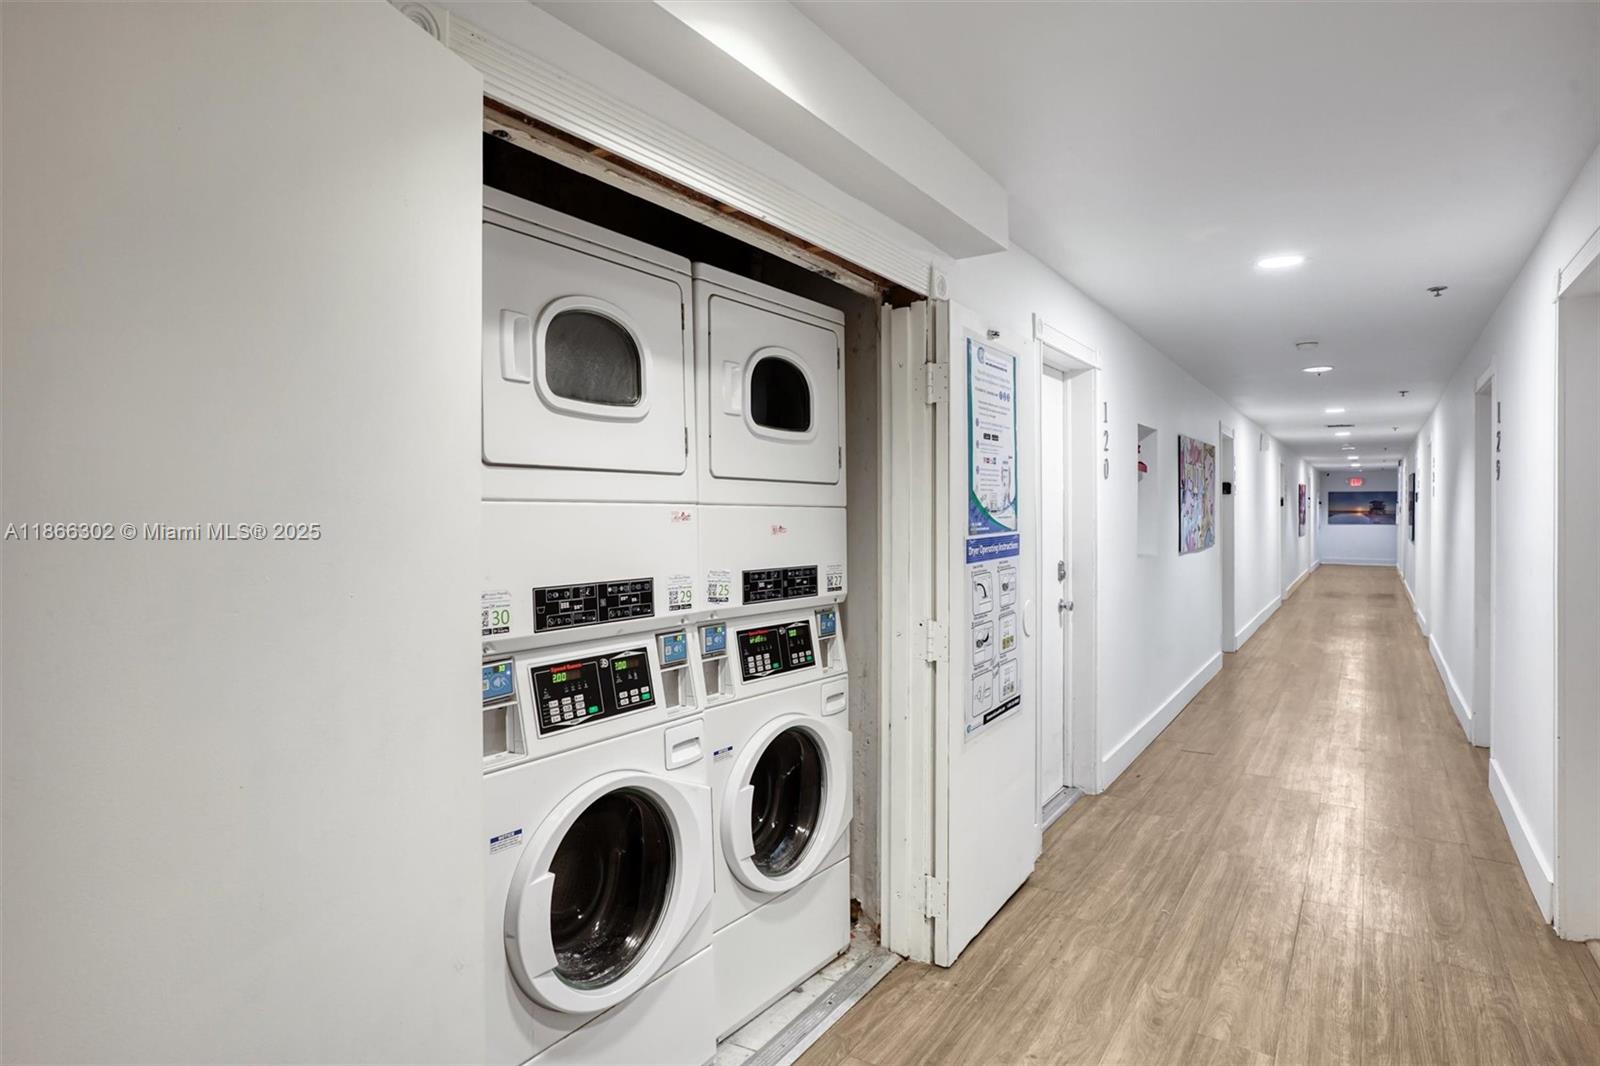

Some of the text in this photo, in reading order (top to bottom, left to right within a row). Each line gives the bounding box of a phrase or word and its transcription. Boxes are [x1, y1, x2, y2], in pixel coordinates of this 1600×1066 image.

[969, 546, 980, 558] Dryer
[980, 543, 999, 555] Operating
[834, 575, 843, 586] 27
[680, 589, 692, 604] 29
[719, 584, 730, 597] 25
[492, 609, 511, 626] 30
